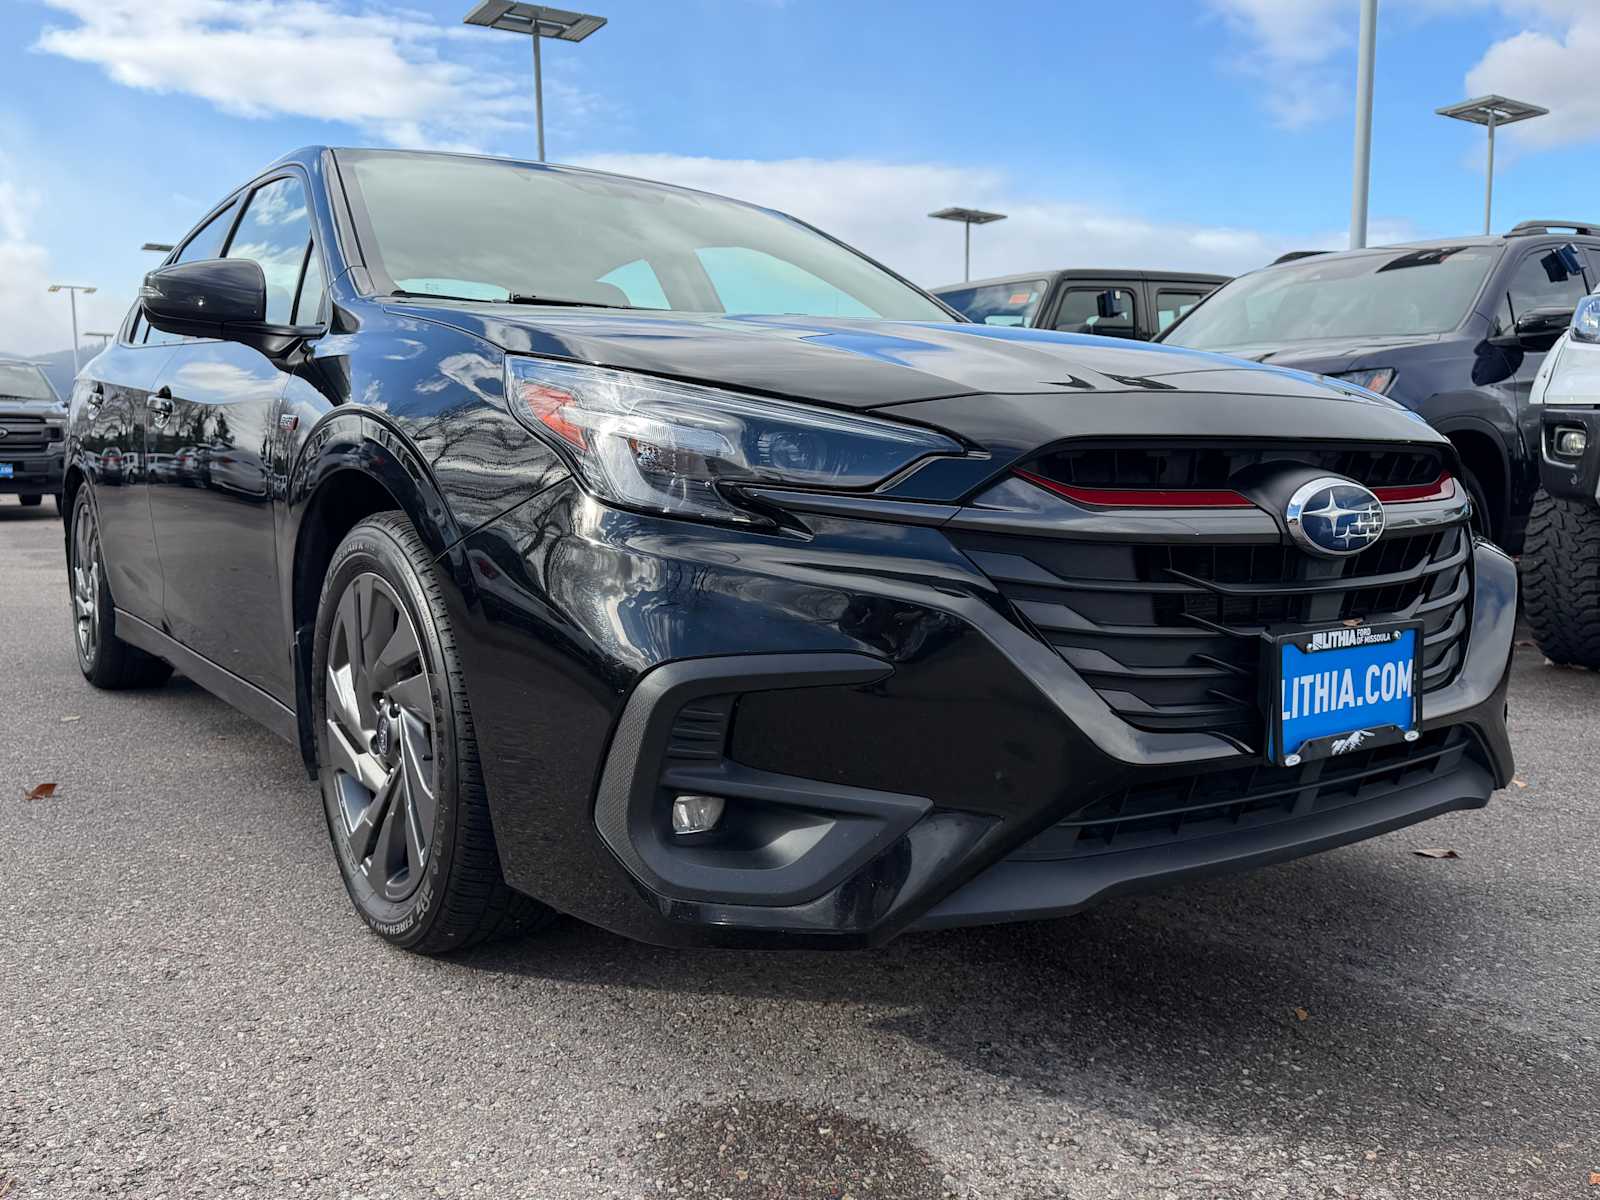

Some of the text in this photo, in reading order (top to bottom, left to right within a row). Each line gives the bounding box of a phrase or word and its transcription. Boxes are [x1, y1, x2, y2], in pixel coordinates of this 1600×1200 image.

[1322, 629, 1356, 649] LITHIA
[1356, 628, 1371, 636] FORD
[1356, 632, 1391, 645] OF MISSOULA
[1281, 658, 1414, 721] LITHIA.COM
